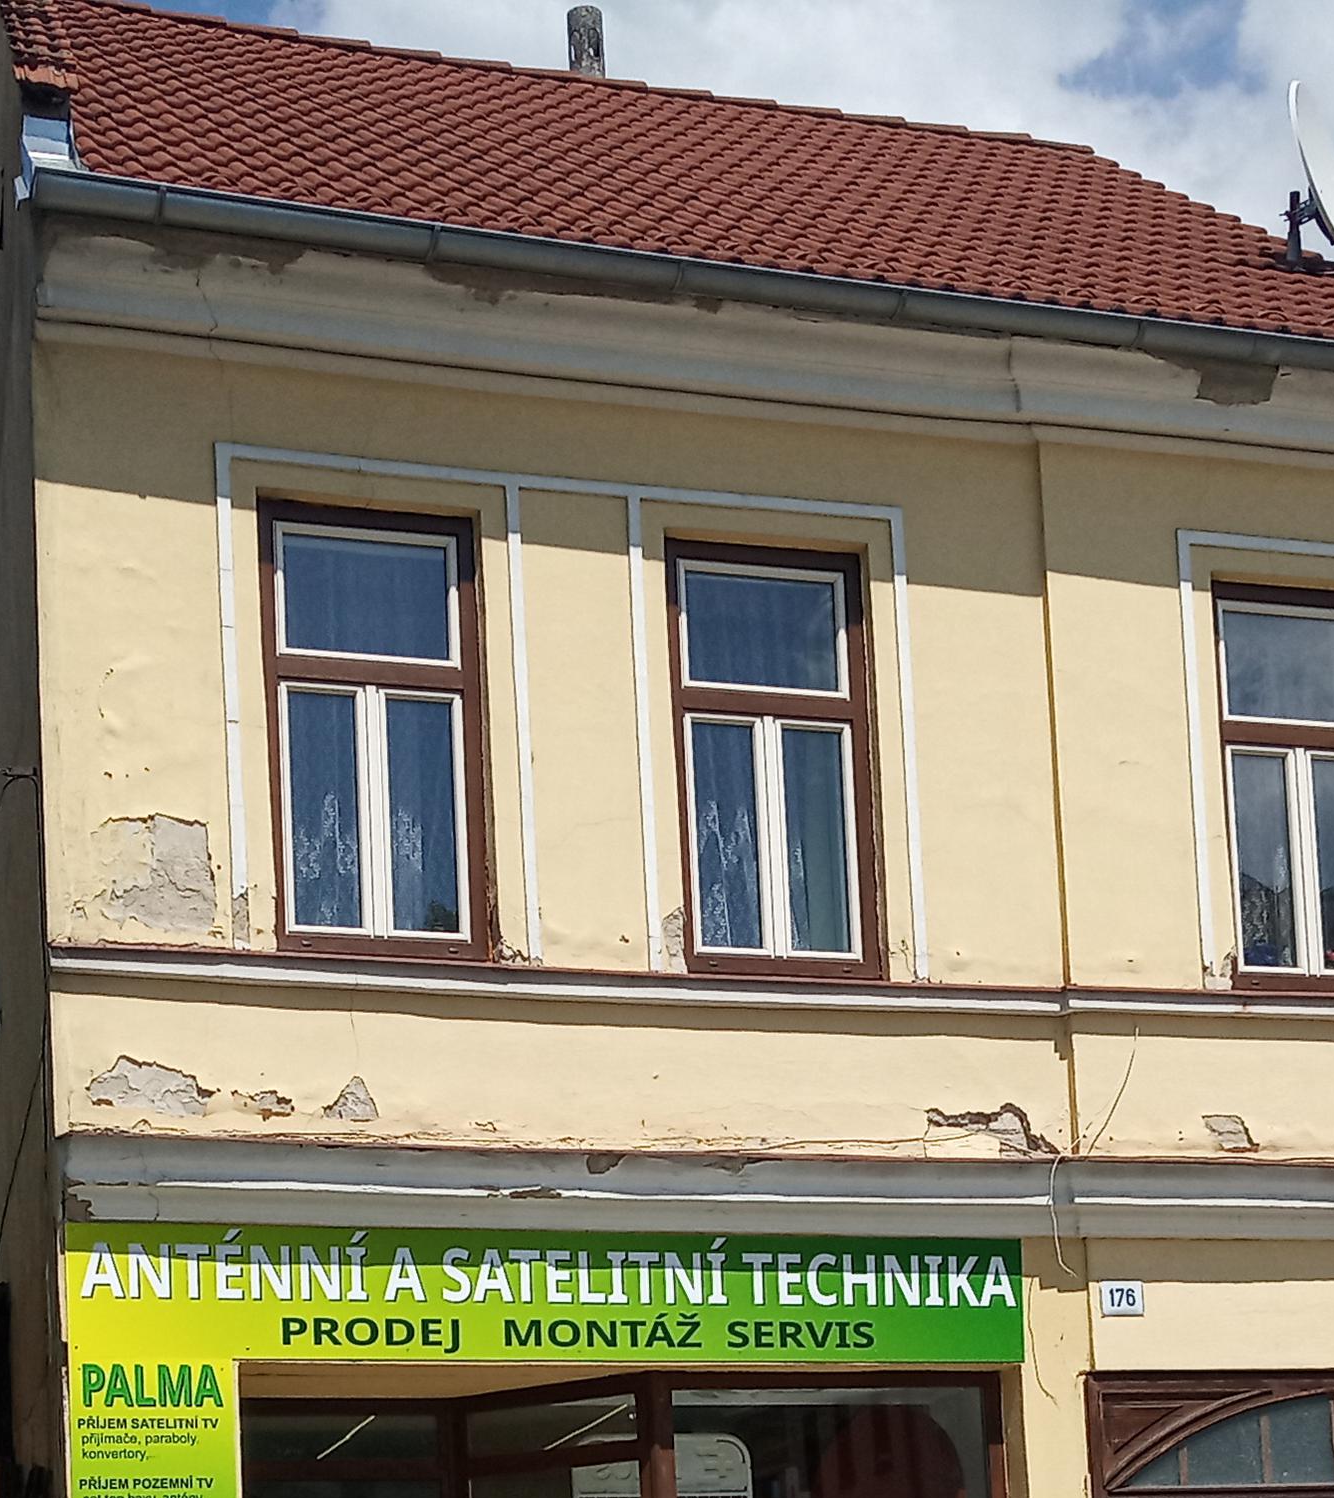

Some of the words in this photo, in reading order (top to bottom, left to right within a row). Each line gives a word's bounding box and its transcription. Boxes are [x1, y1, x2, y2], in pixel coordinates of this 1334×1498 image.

[80, 1229, 370, 1303] ANTÉNNÍ
[383, 1245, 428, 1304] A
[441, 1236, 729, 1307] SATELITNÍ
[741, 1252, 1019, 1309] TECHNIKA
[1108, 1288, 1137, 1308] 176
[280, 1316, 462, 1354] PRODEJ
[503, 1311, 702, 1349] MONTÁŽ
[726, 1319, 876, 1350] SERVIS
[81, 1363, 224, 1408] PALMA
[77, 1415, 128, 1429] PŘÍJEM
[130, 1415, 198, 1429] SATELITNÍ
[201, 1418, 219, 1429] TV
[81, 1432, 142, 1446] přijímače,
[79, 1476, 129, 1490] PŘÍJEM
[132, 1475, 193, 1489] POZEMNÍ
[196, 1477, 214, 1489] TV
